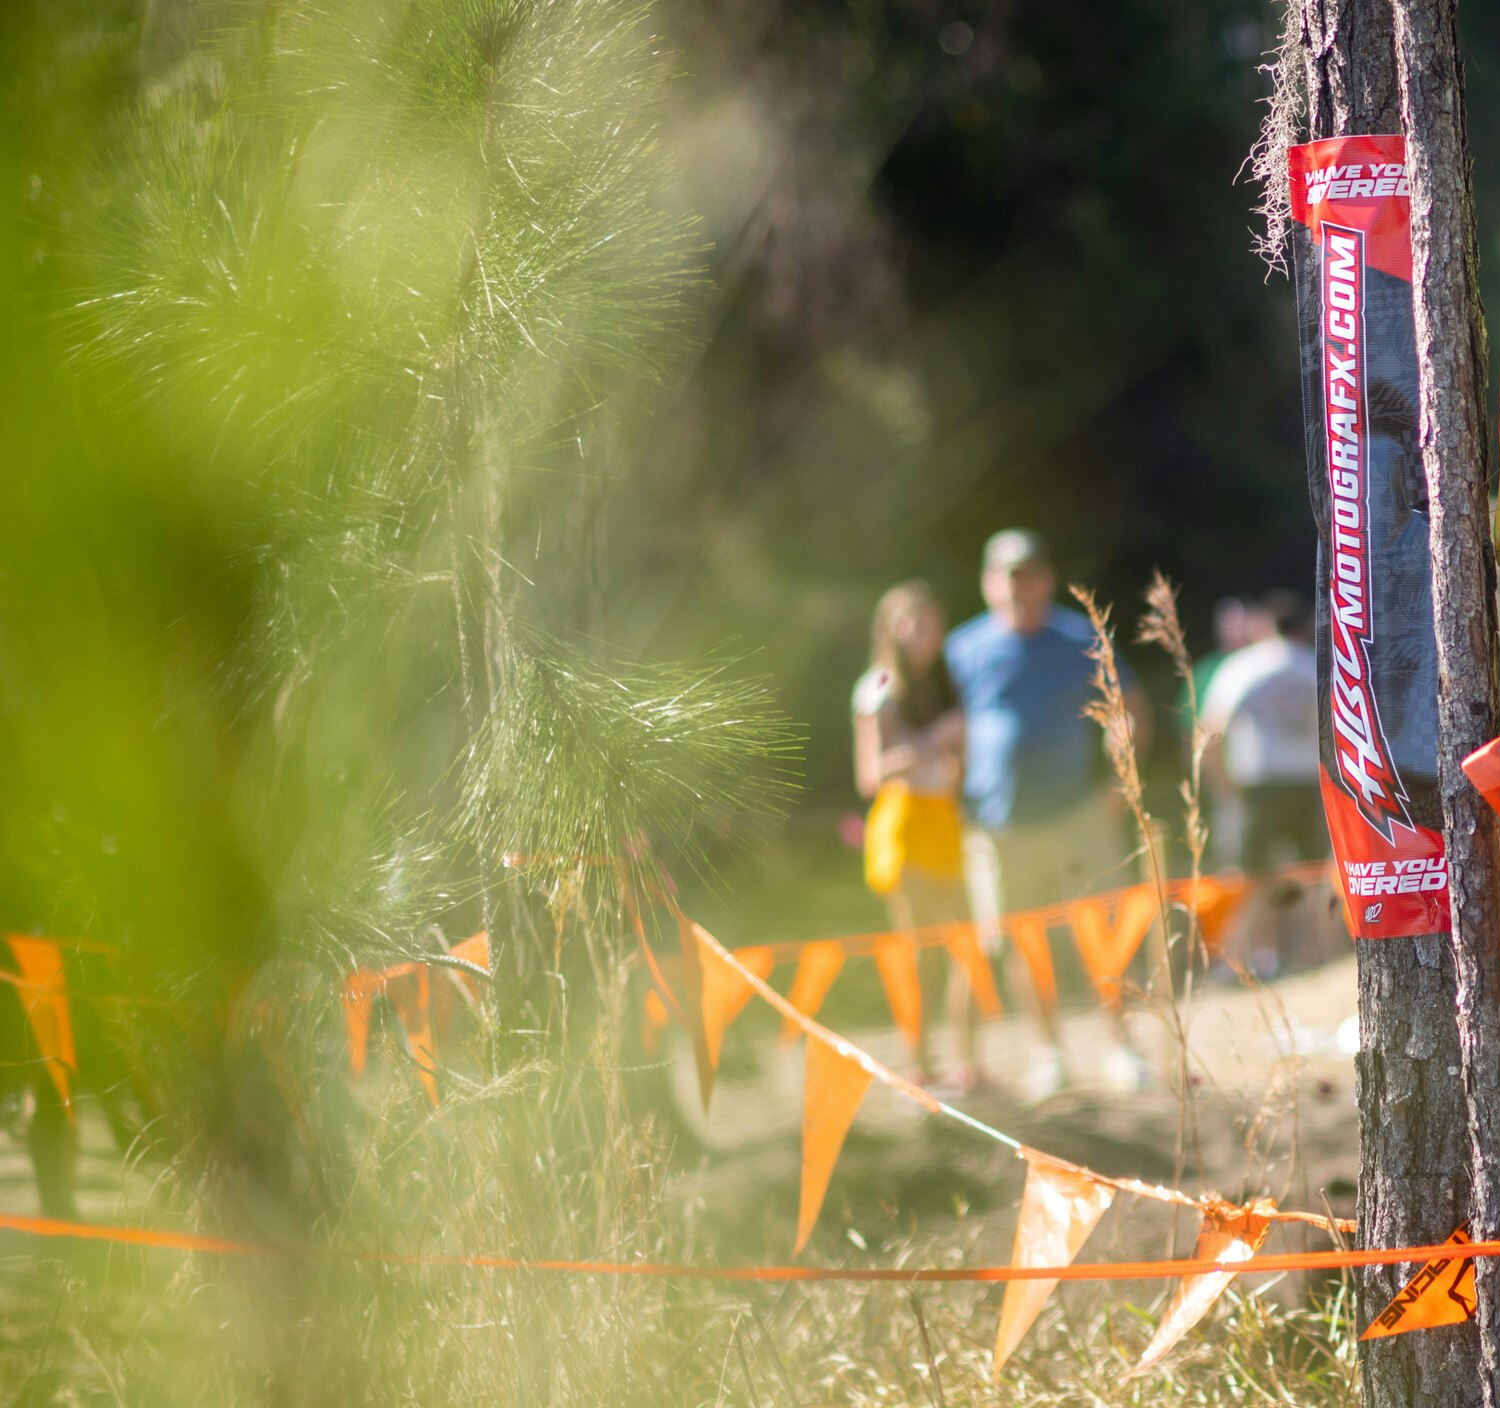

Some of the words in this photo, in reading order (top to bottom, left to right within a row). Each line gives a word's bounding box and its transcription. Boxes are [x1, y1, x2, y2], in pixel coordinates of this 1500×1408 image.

[1330, 234, 1364, 629] MOTOGRAFX.COM
[1348, 861, 1387, 877] HAVE
[1392, 857, 1446, 875] YOU
